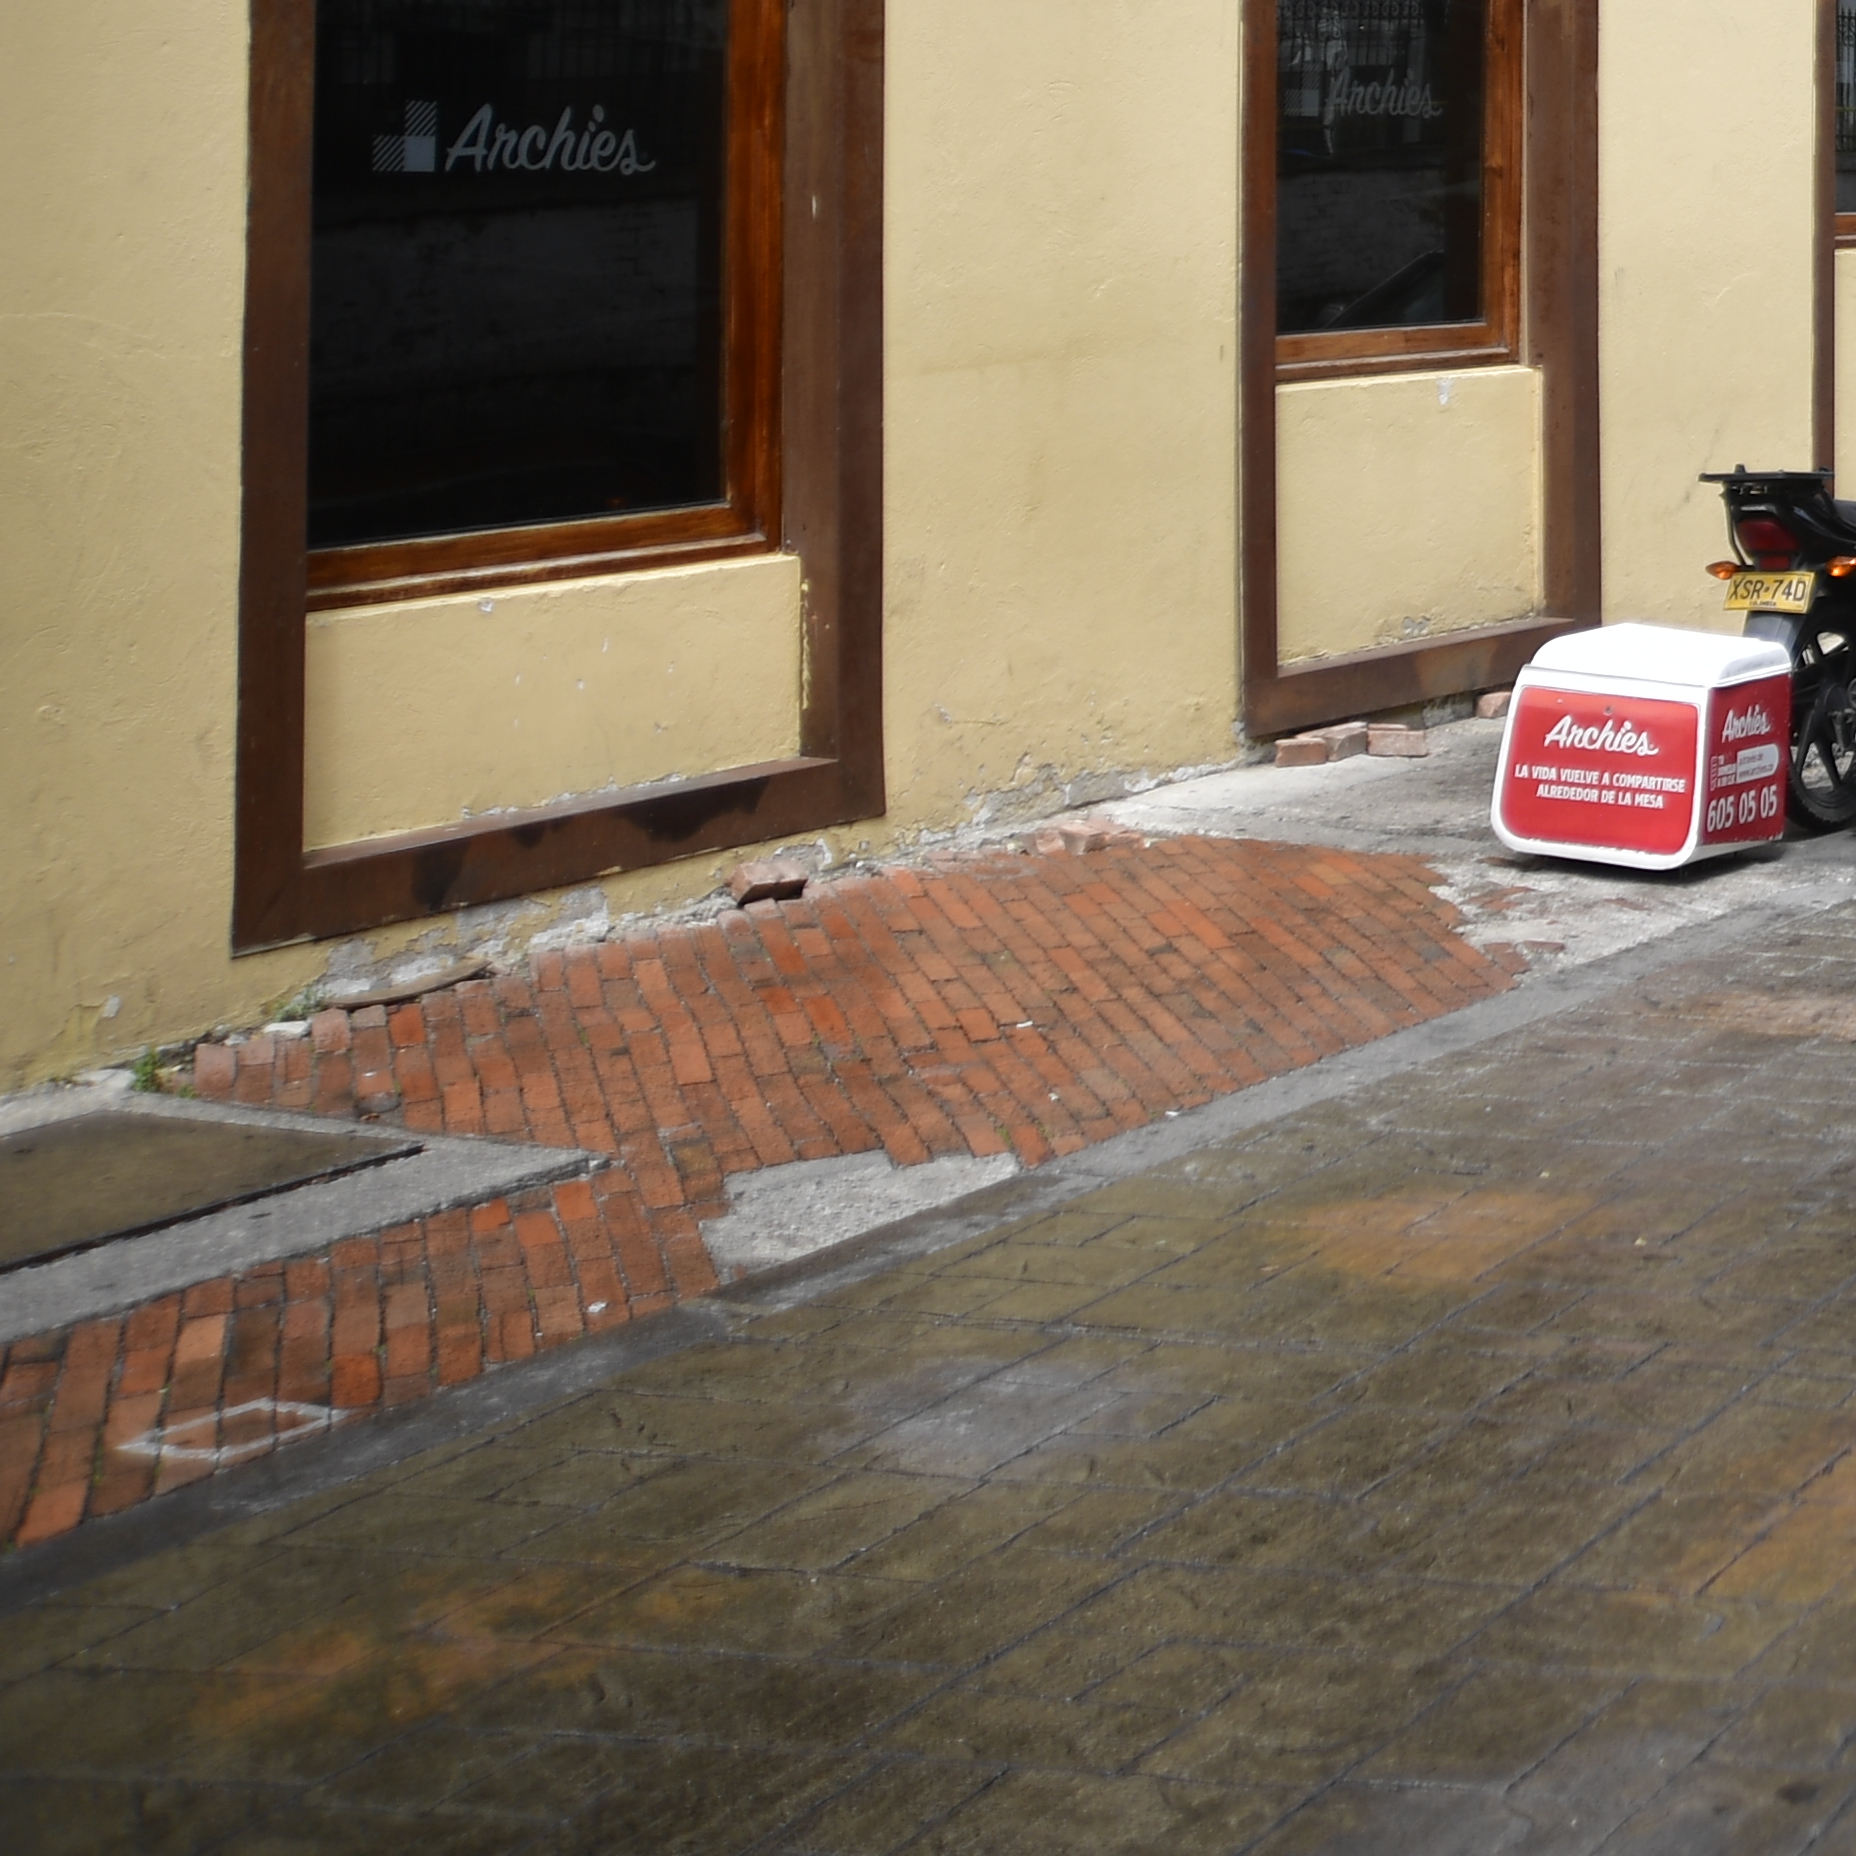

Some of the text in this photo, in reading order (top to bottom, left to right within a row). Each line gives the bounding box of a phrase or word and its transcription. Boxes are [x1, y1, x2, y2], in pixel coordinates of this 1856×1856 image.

[1325, 66, 1443, 119] Archies
[445, 103, 657, 176] Archies
[1544, 715, 1659, 756] Archies
[1721, 704, 1771, 743] Archies
[1514, 764, 1686, 792] LA VIDA VUELVE A COMPARTIRSE
[1536, 784, 1664, 809] ALREDEDOR DE LA MESA
[1706, 784, 1778, 833] 605 05 05
